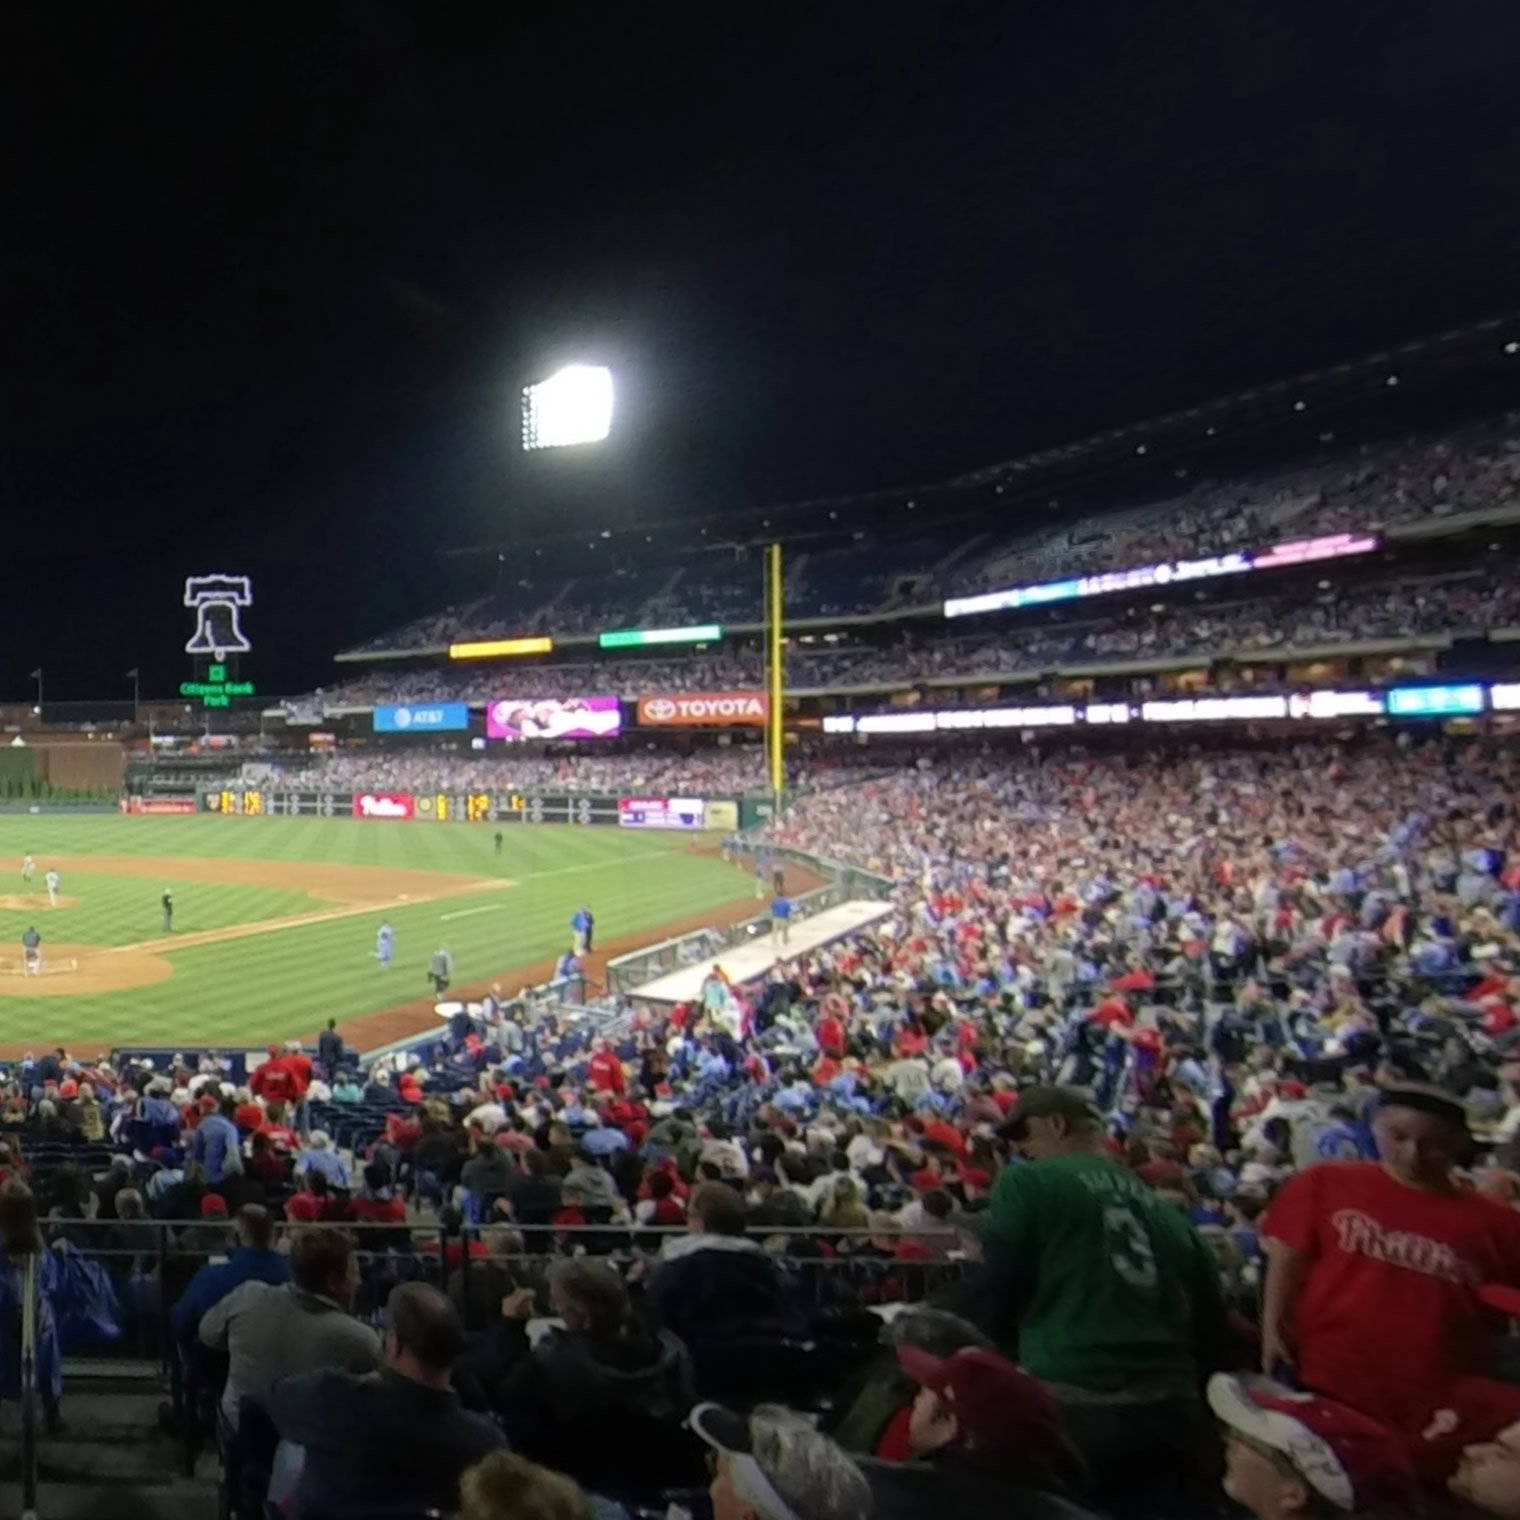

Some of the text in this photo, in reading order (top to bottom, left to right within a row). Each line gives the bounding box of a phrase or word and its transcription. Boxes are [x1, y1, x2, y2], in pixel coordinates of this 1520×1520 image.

[225, 682, 253, 695] Bank
[677, 698, 763, 717] TOYOTA
[412, 709, 444, 724] AT&T
[1102, 1206, 1159, 1288] 3
